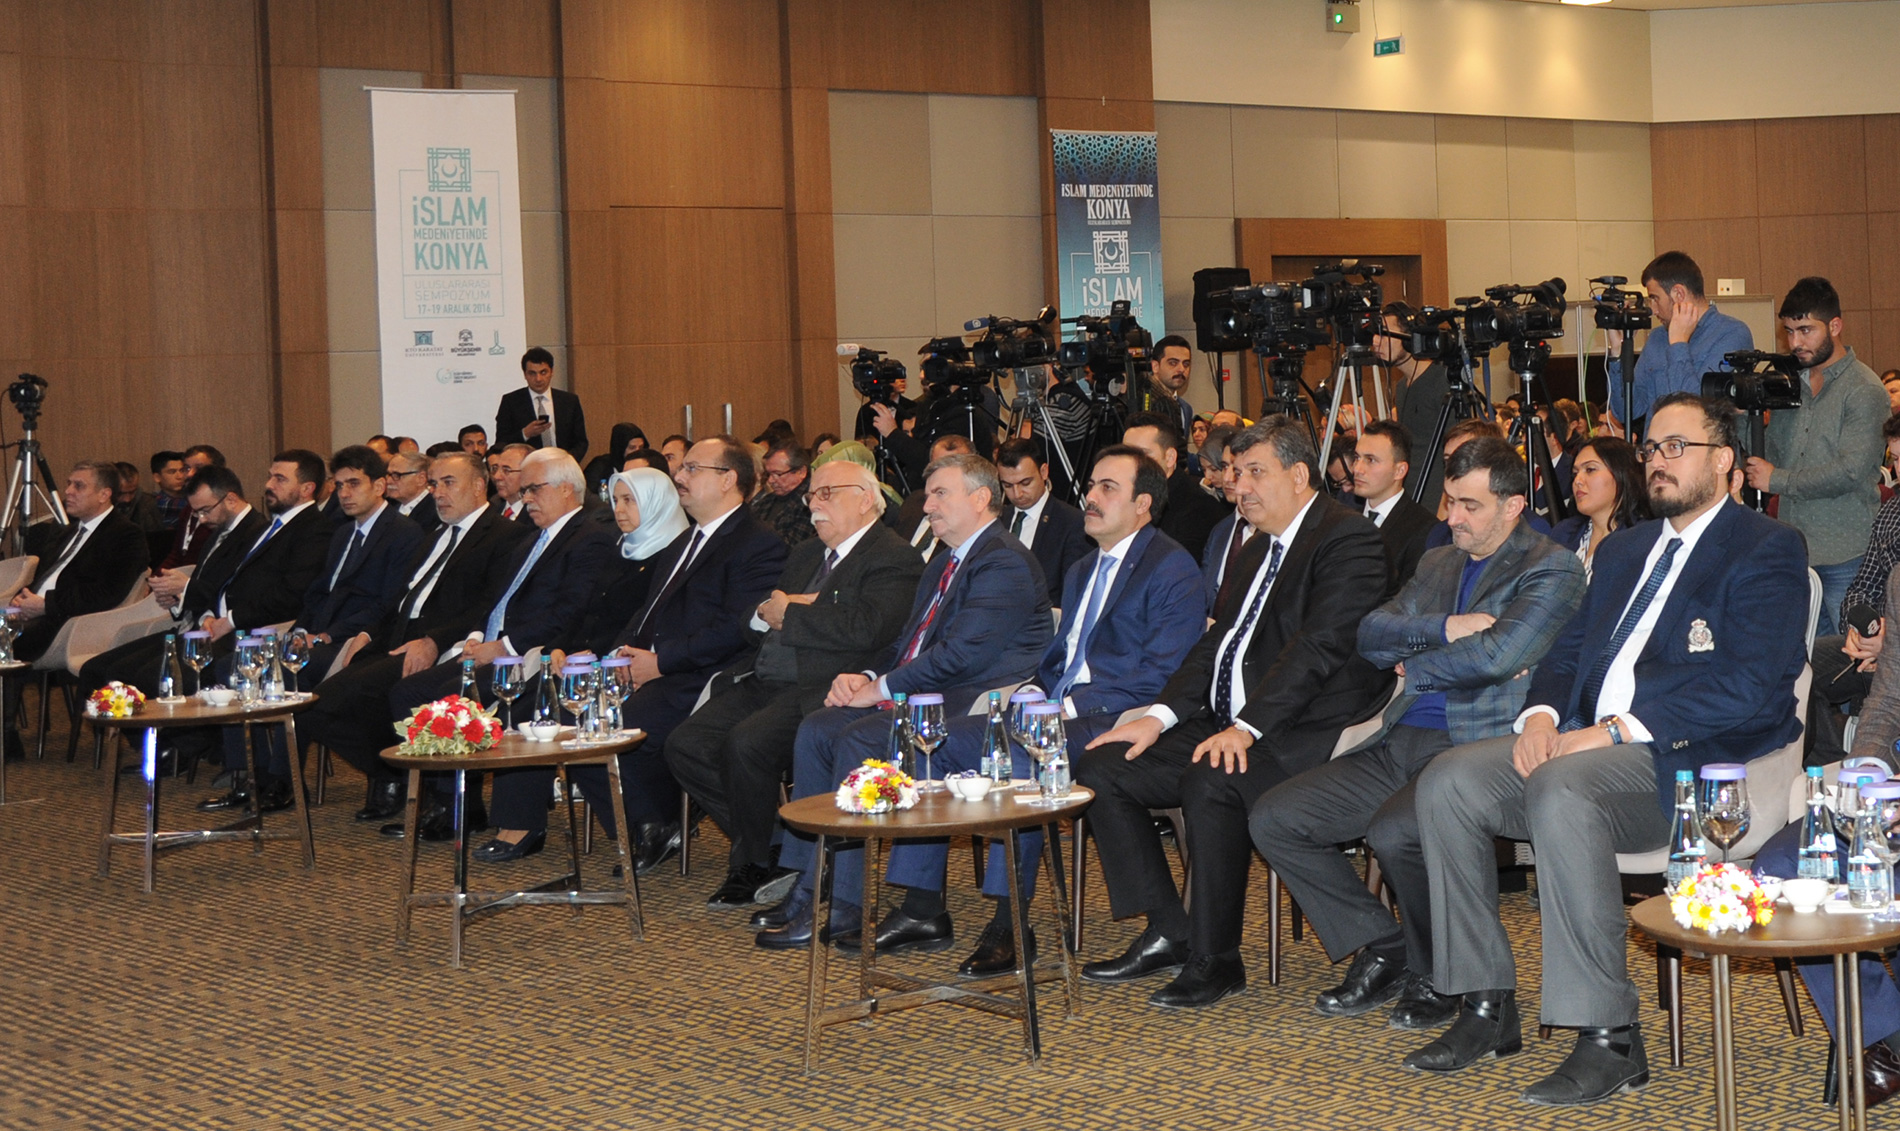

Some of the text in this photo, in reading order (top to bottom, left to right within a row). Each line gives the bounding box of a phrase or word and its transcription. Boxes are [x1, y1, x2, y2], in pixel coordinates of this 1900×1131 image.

[1086, 199, 1131, 219] KONYA
[414, 242, 488, 270] KONYA
[415, 279, 491, 289] ULUSLARARASI
[415, 290, 491, 301] SEMPOZYUM
[443, 304, 471, 314] ARALIK
[473, 303, 491, 313] 2016
